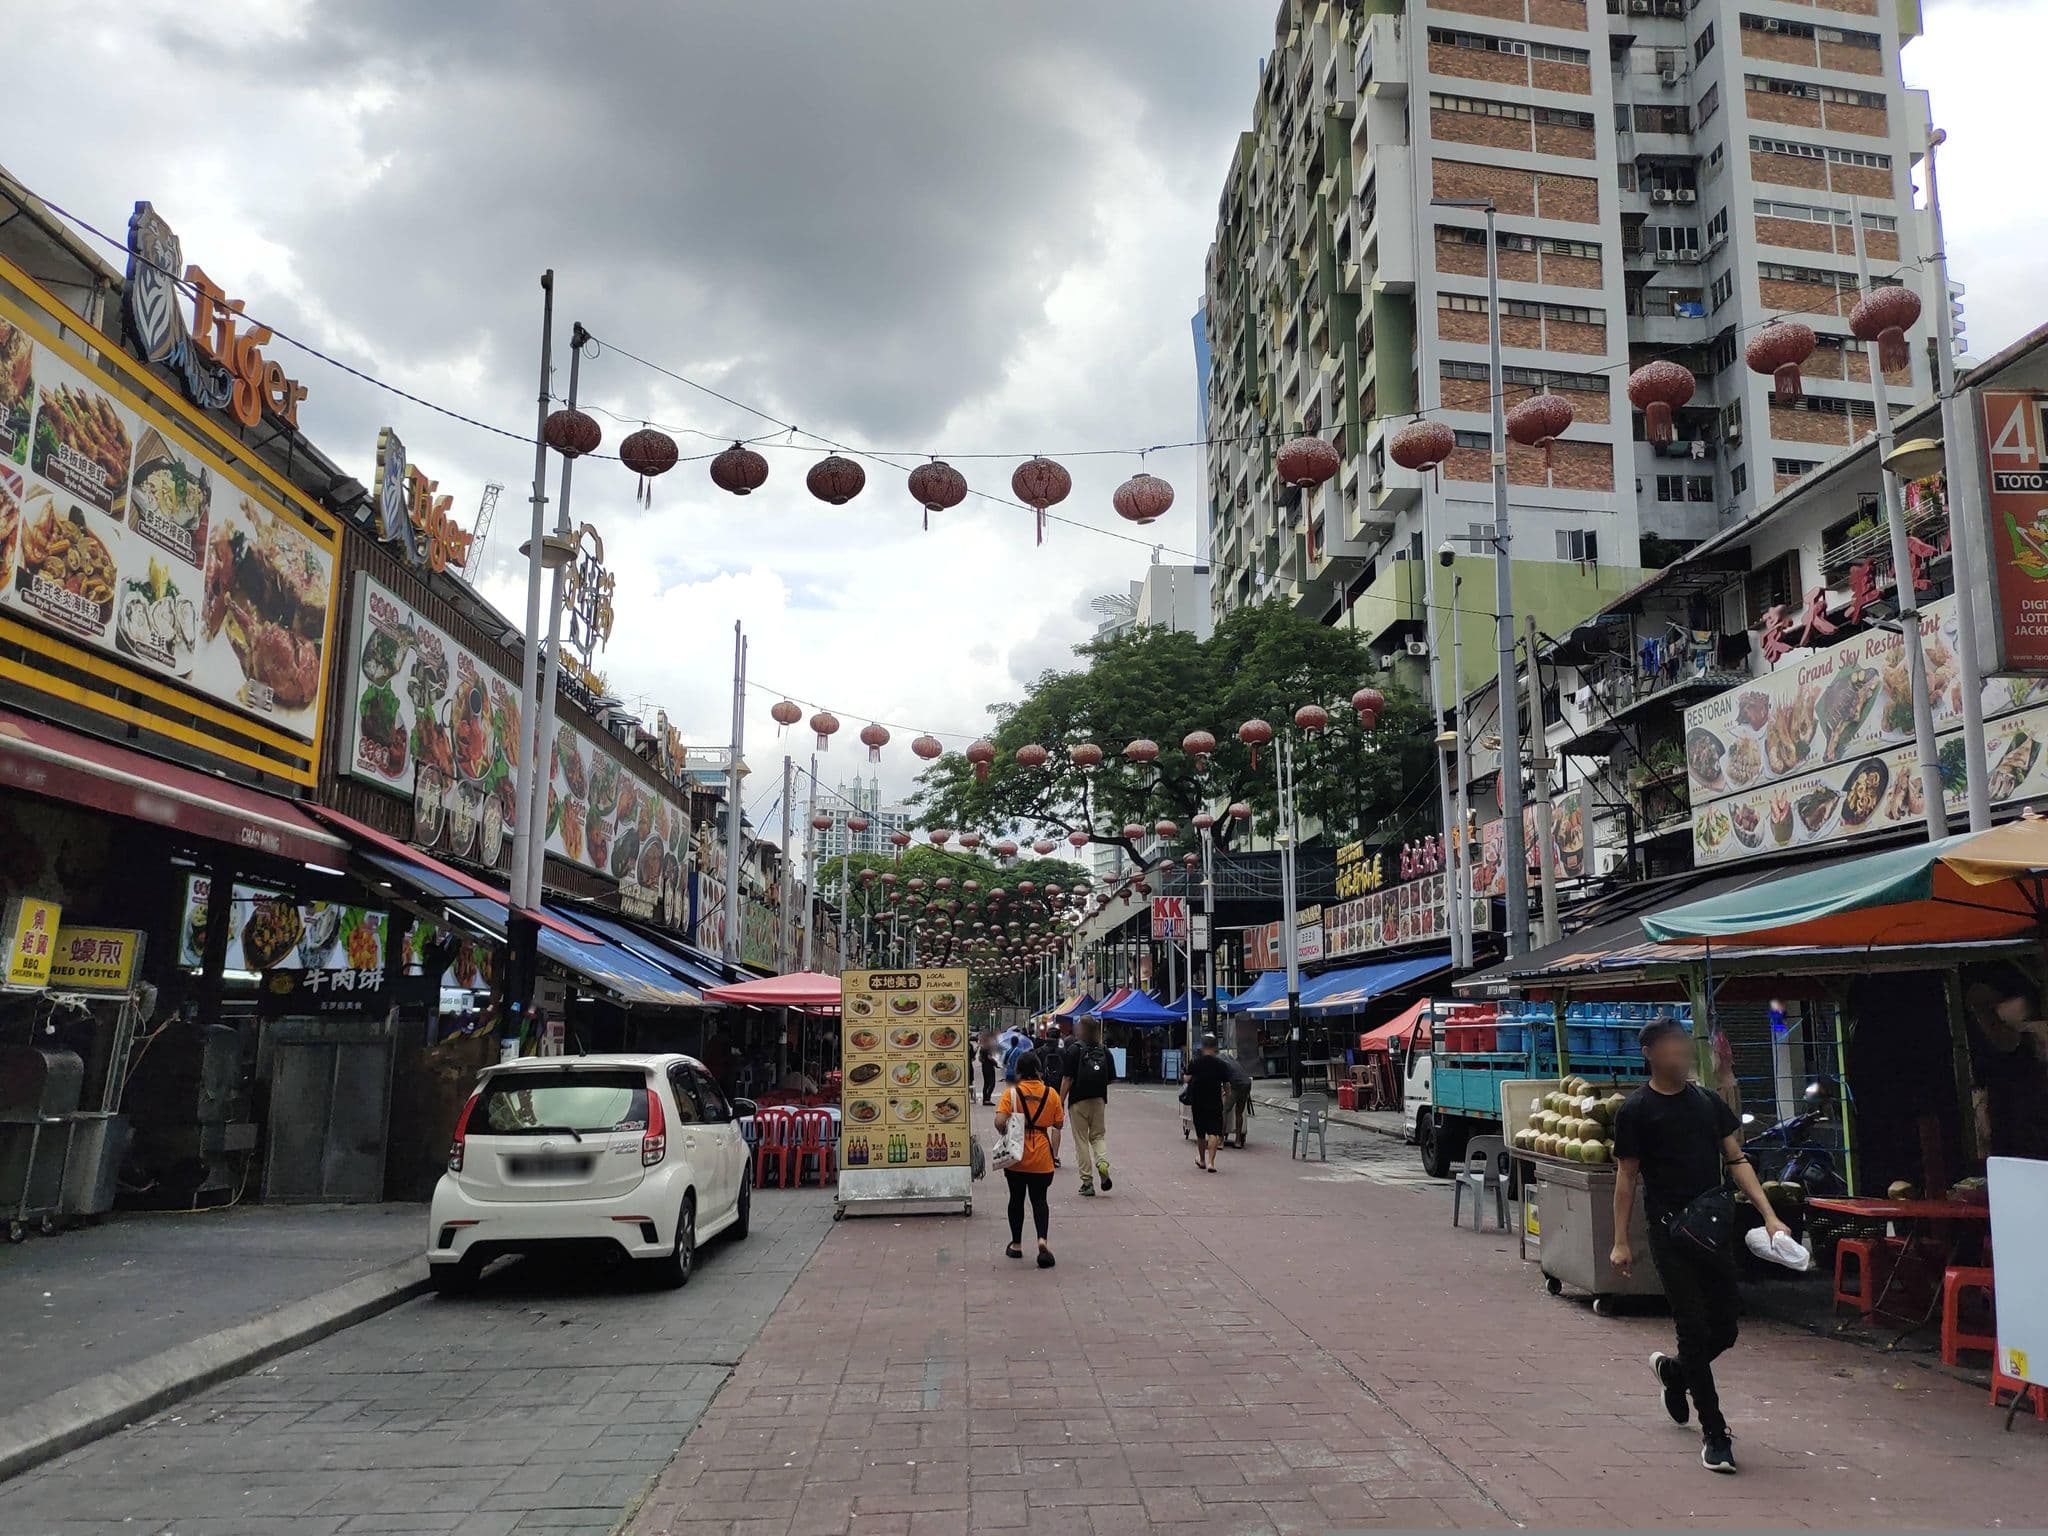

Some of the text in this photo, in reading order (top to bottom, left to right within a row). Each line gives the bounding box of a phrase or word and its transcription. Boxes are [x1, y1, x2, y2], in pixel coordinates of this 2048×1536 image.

[1998, 475, 2043, 489] TOTO
[1798, 655, 1833, 686] Grand
[1839, 649, 1860, 670] Sky
[1687, 696, 1732, 729] RESTORAN
[1154, 897, 1183, 918] KK
[22, 957, 39, 970] BBQ
[50, 966, 121, 979] RIED OYSTER
[303, 967, 385, 993] 牛肉饼
[870, 975, 919, 989] 本地美食
